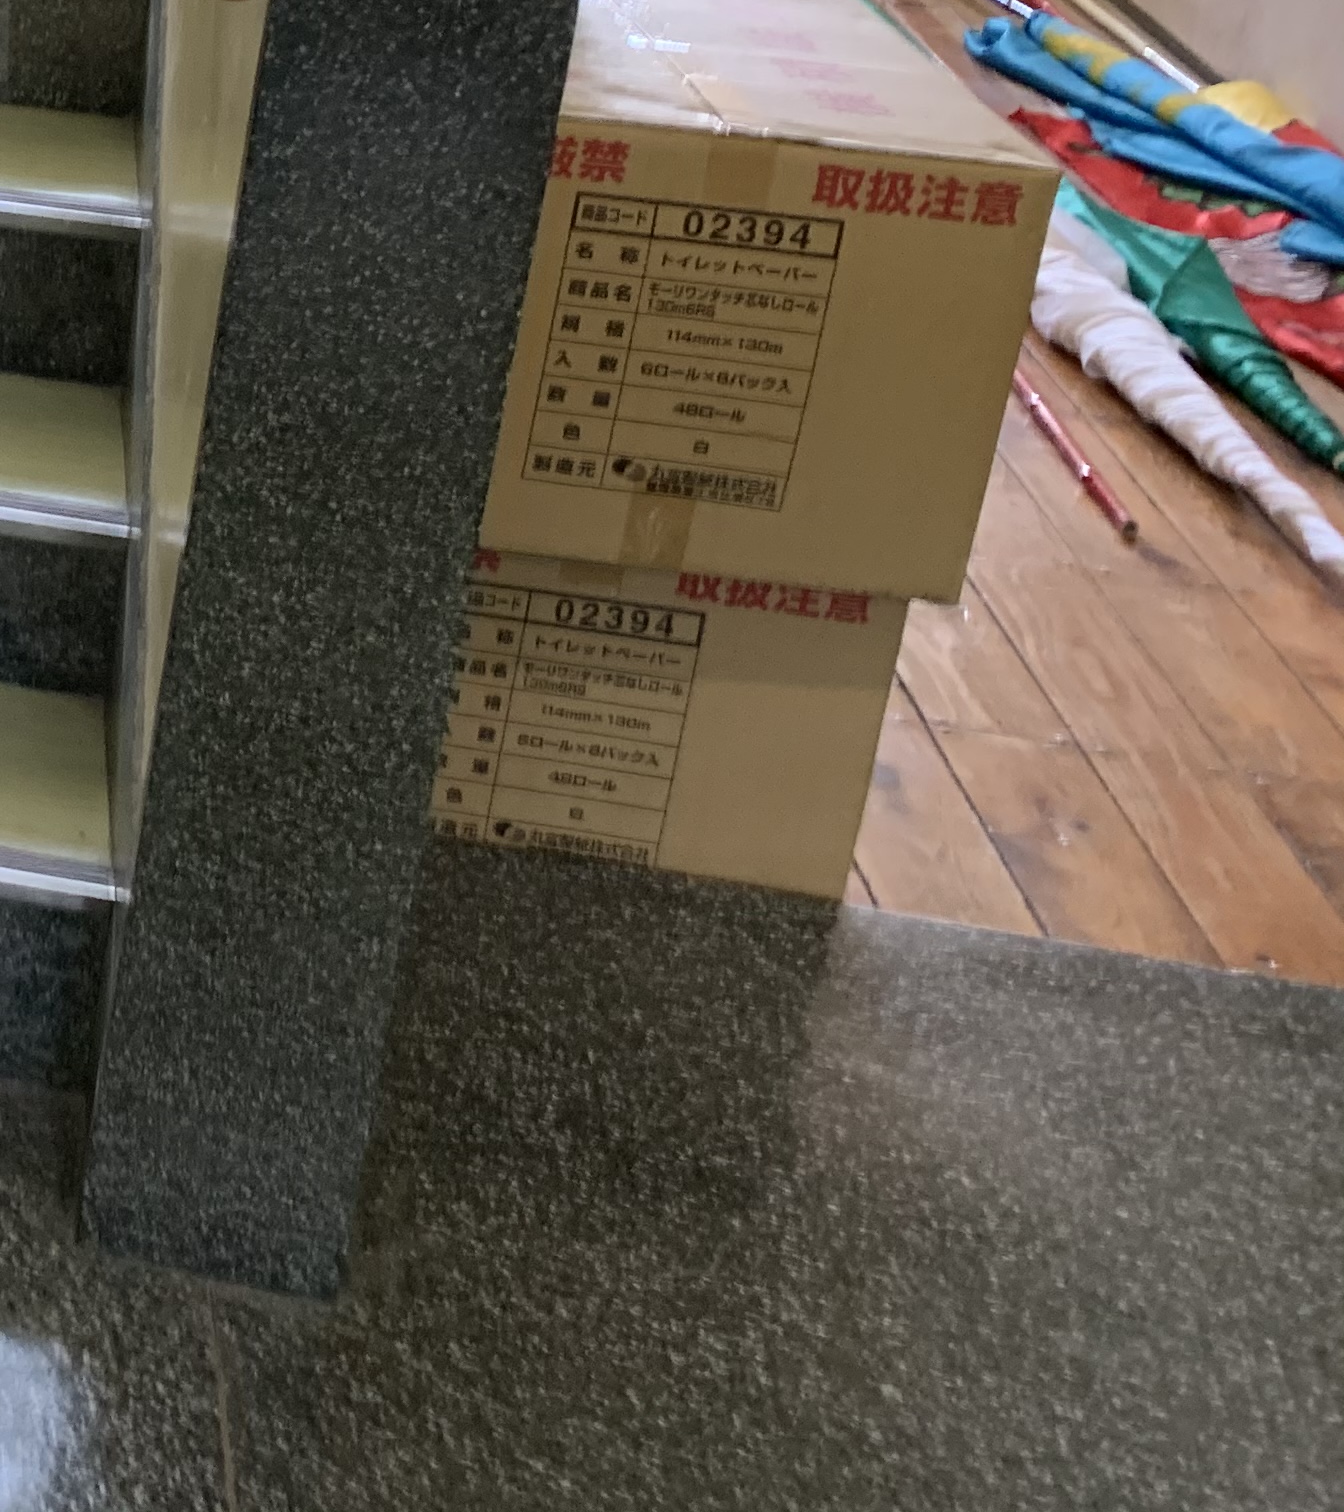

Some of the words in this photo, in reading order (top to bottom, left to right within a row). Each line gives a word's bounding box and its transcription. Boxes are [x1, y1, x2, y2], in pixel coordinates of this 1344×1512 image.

[812, 164, 1023, 226] 取扱注意
[683, 209, 811, 249] 02394
[661, 252, 817, 281] トイレットペーパー
[555, 599, 674, 637] 02394
[535, 636, 681, 665] トイレットペーパー
